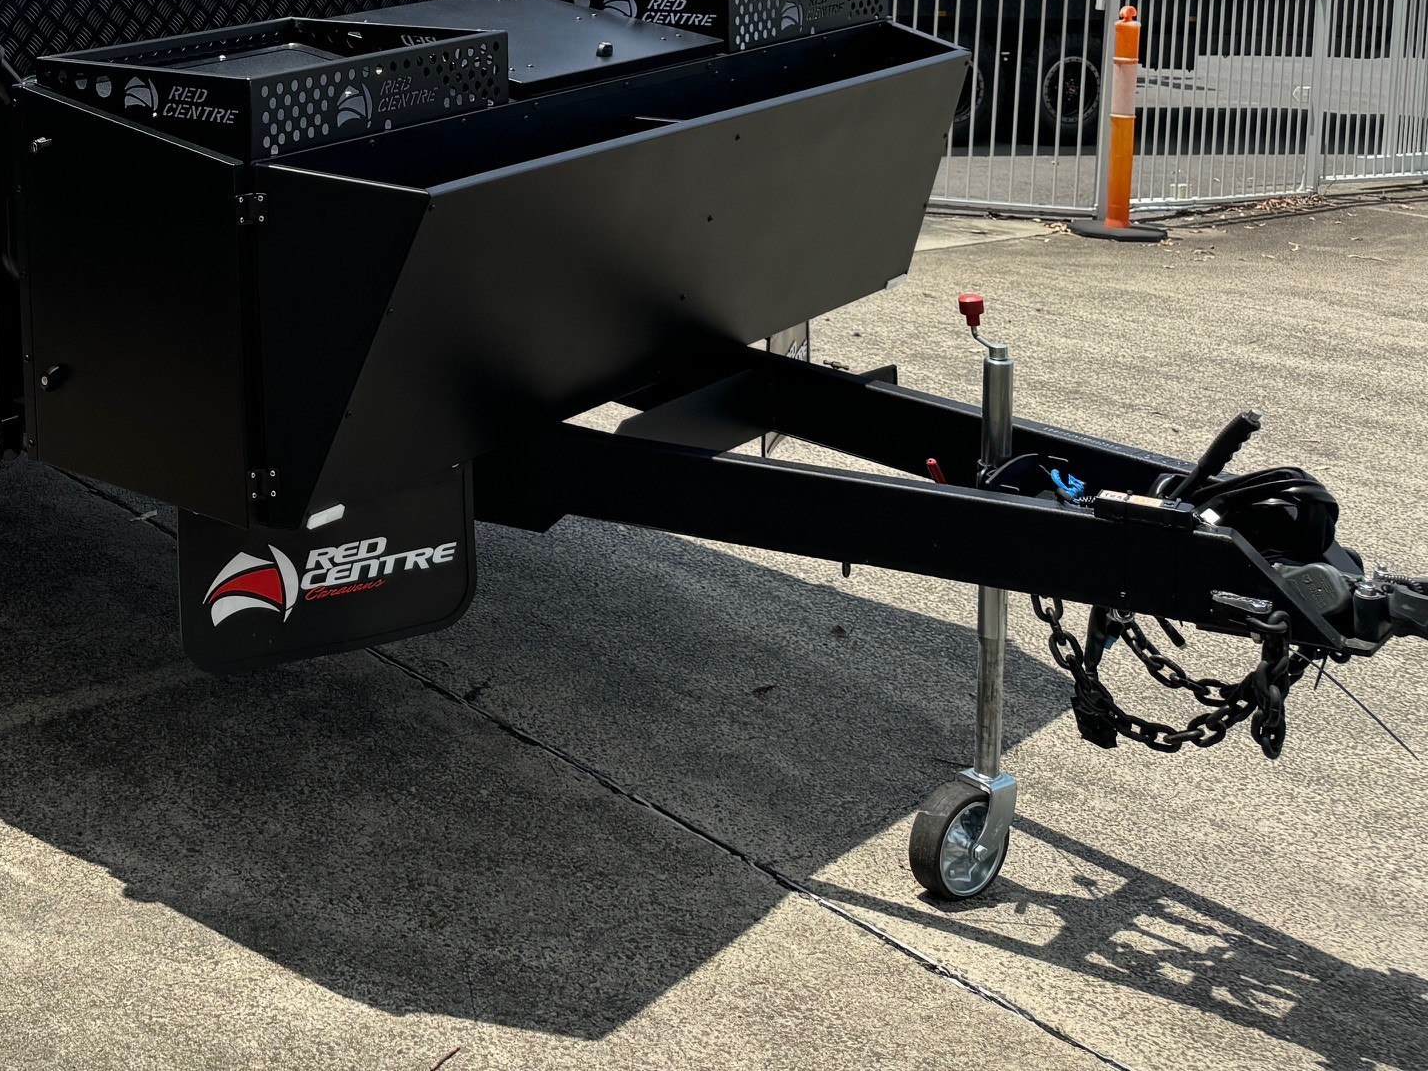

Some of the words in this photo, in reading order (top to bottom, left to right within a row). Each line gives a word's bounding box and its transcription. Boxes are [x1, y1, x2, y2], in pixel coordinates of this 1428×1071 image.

[641, 11, 717, 26] CENTRE
[169, 85, 209, 102] RED
[379, 75, 413, 93] RED
[378, 87, 438, 113] CENTRE
[163, 103, 239, 125] CENTRE
[305, 536, 387, 570] RED
[300, 541, 457, 590] CENTRE
[304, 578, 386, 601] Caravans
